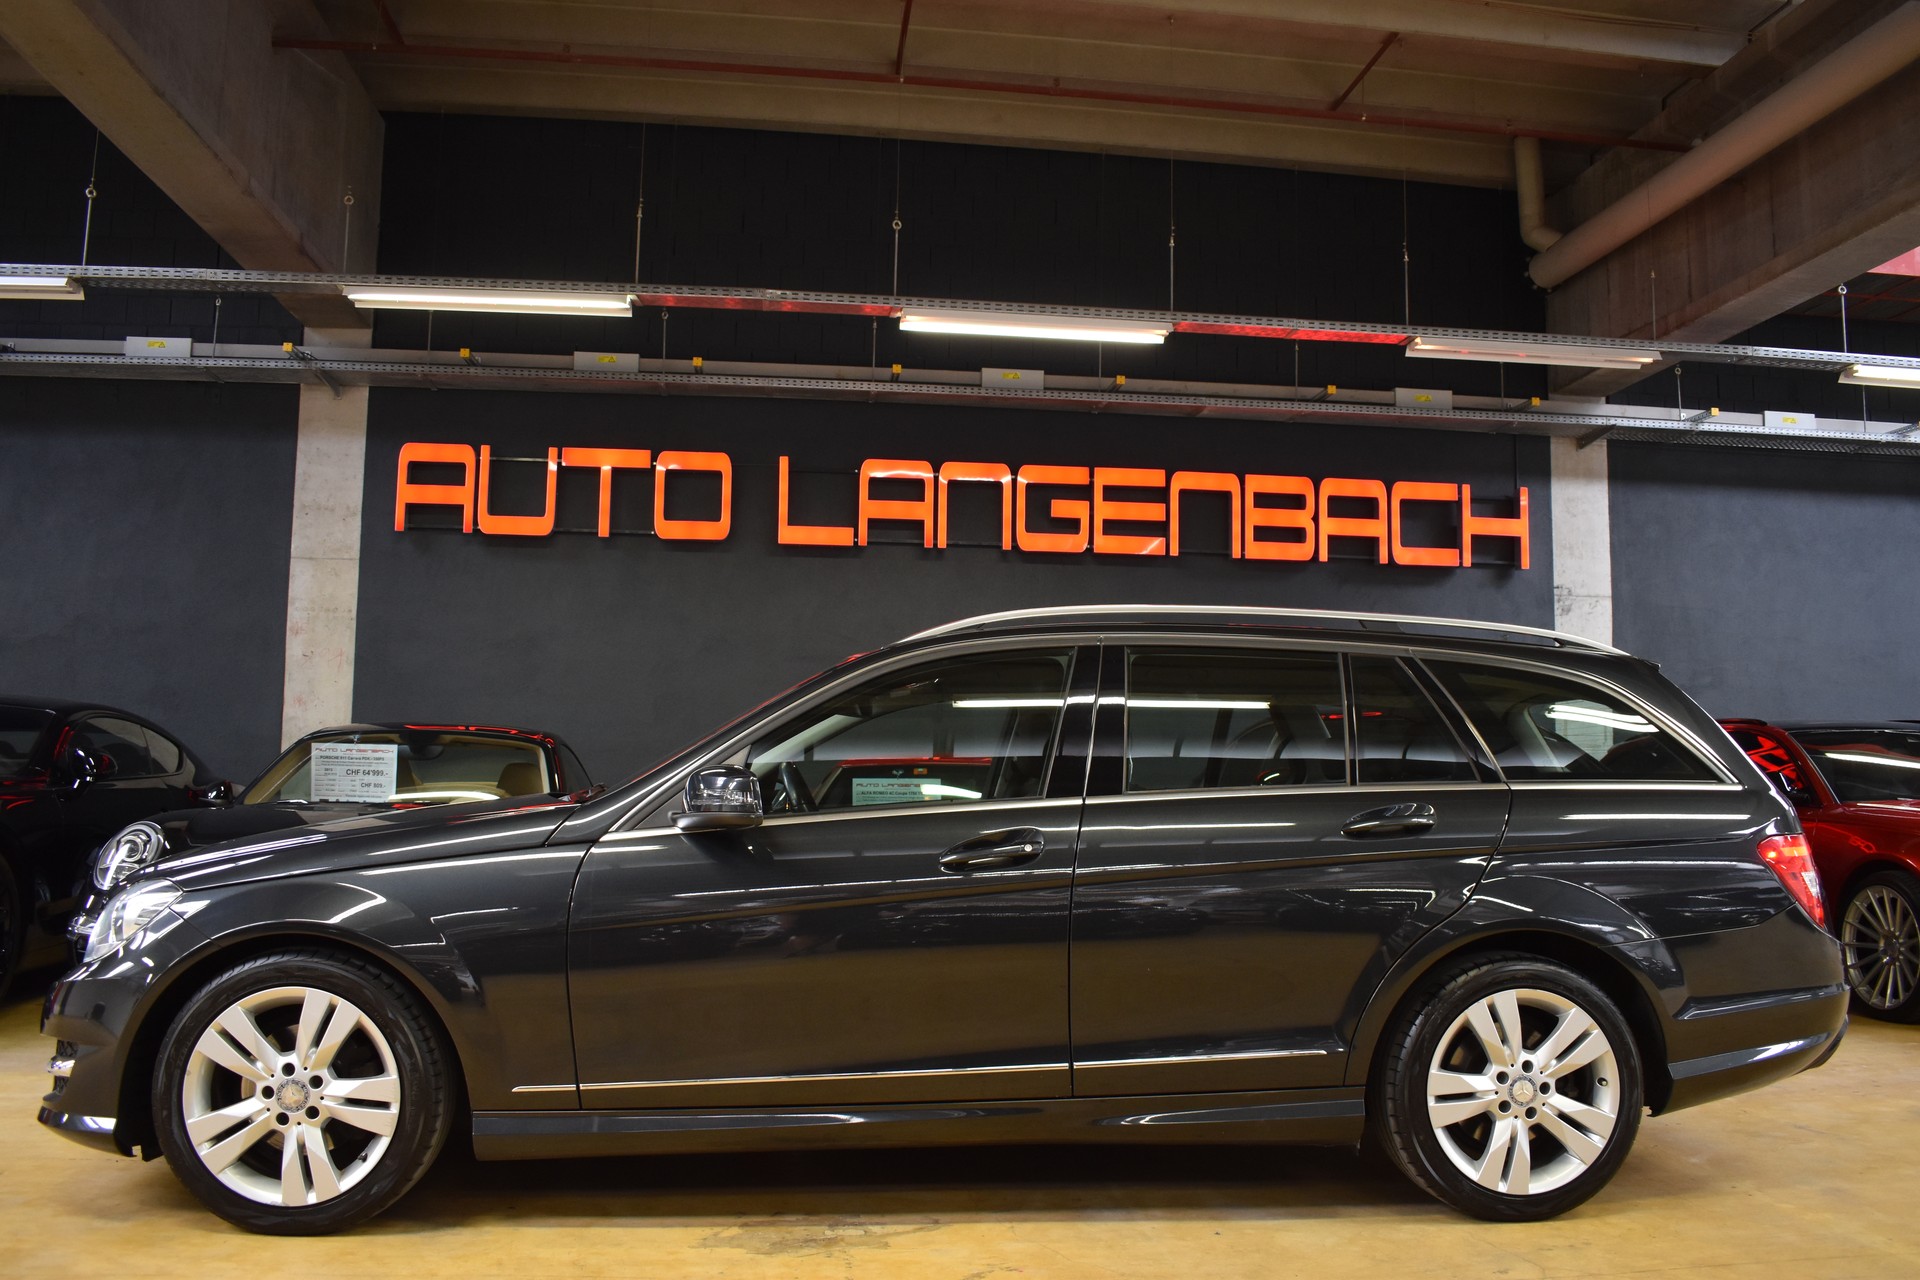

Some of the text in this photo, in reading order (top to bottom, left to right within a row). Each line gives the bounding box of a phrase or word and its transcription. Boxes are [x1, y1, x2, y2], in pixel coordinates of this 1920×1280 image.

[395, 442, 1530, 569] AUTO LANGENBACH
[346, 768, 361, 776] CHF
